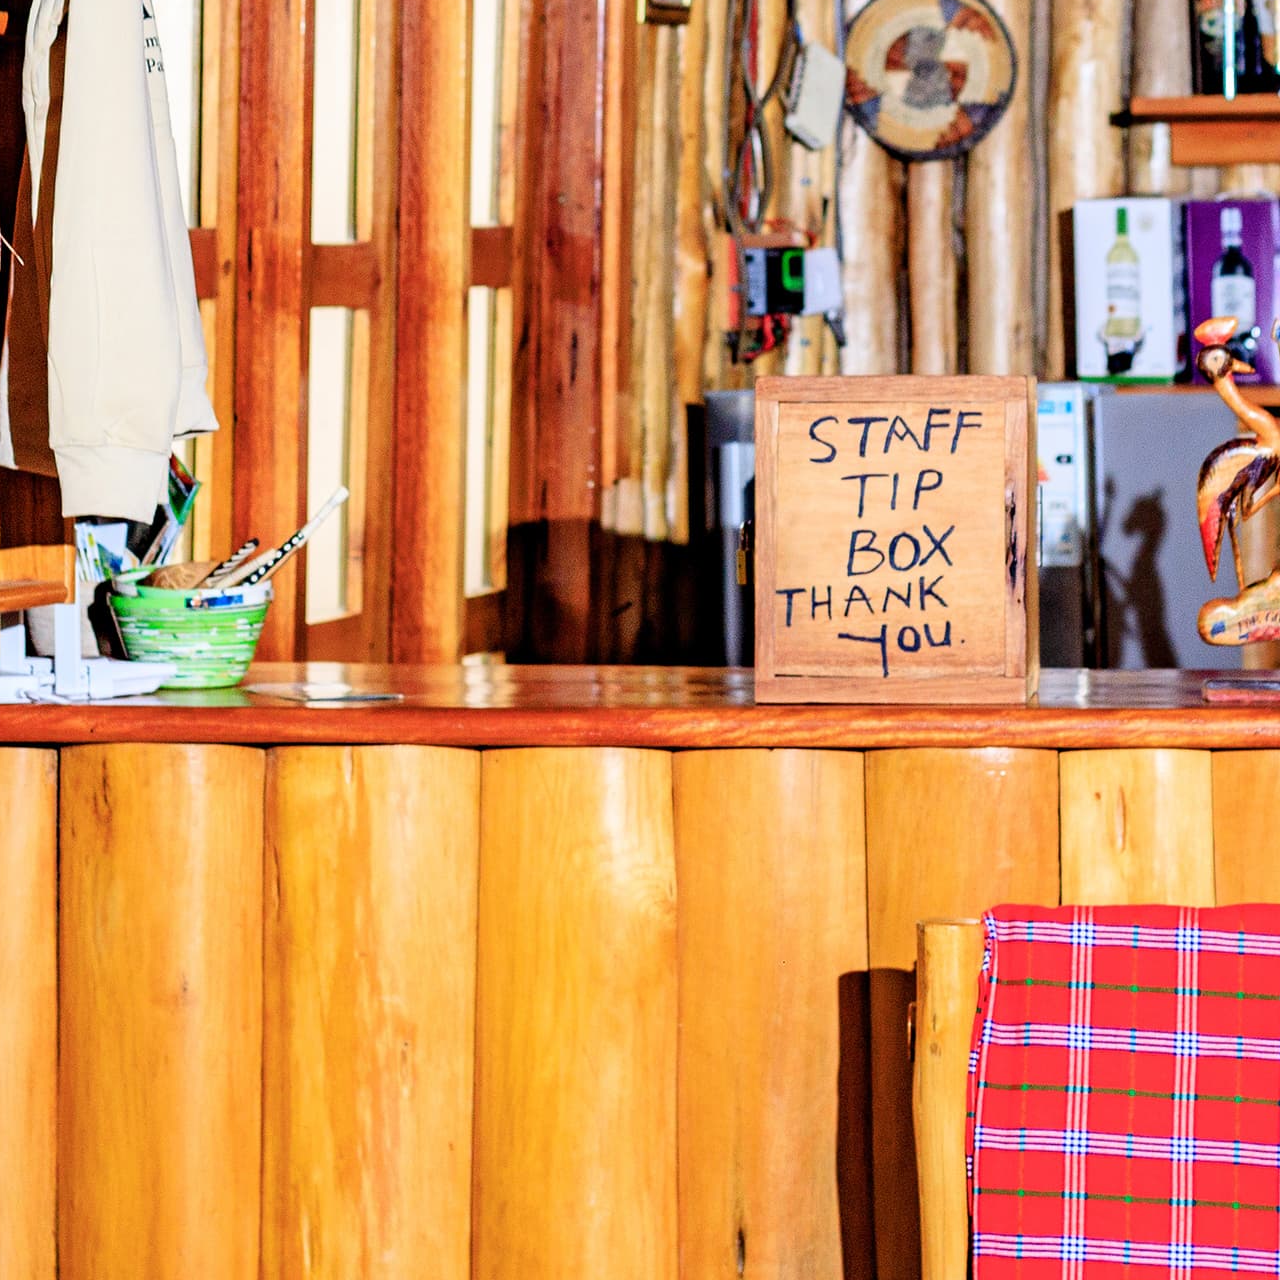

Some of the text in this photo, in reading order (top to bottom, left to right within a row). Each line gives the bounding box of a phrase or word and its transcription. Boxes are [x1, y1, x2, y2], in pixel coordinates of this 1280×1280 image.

[808, 407, 983, 464] STAFF
[841, 468, 943, 519] TIP
[847, 524, 956, 577] BOX
[775, 575, 949, 628] THANK
